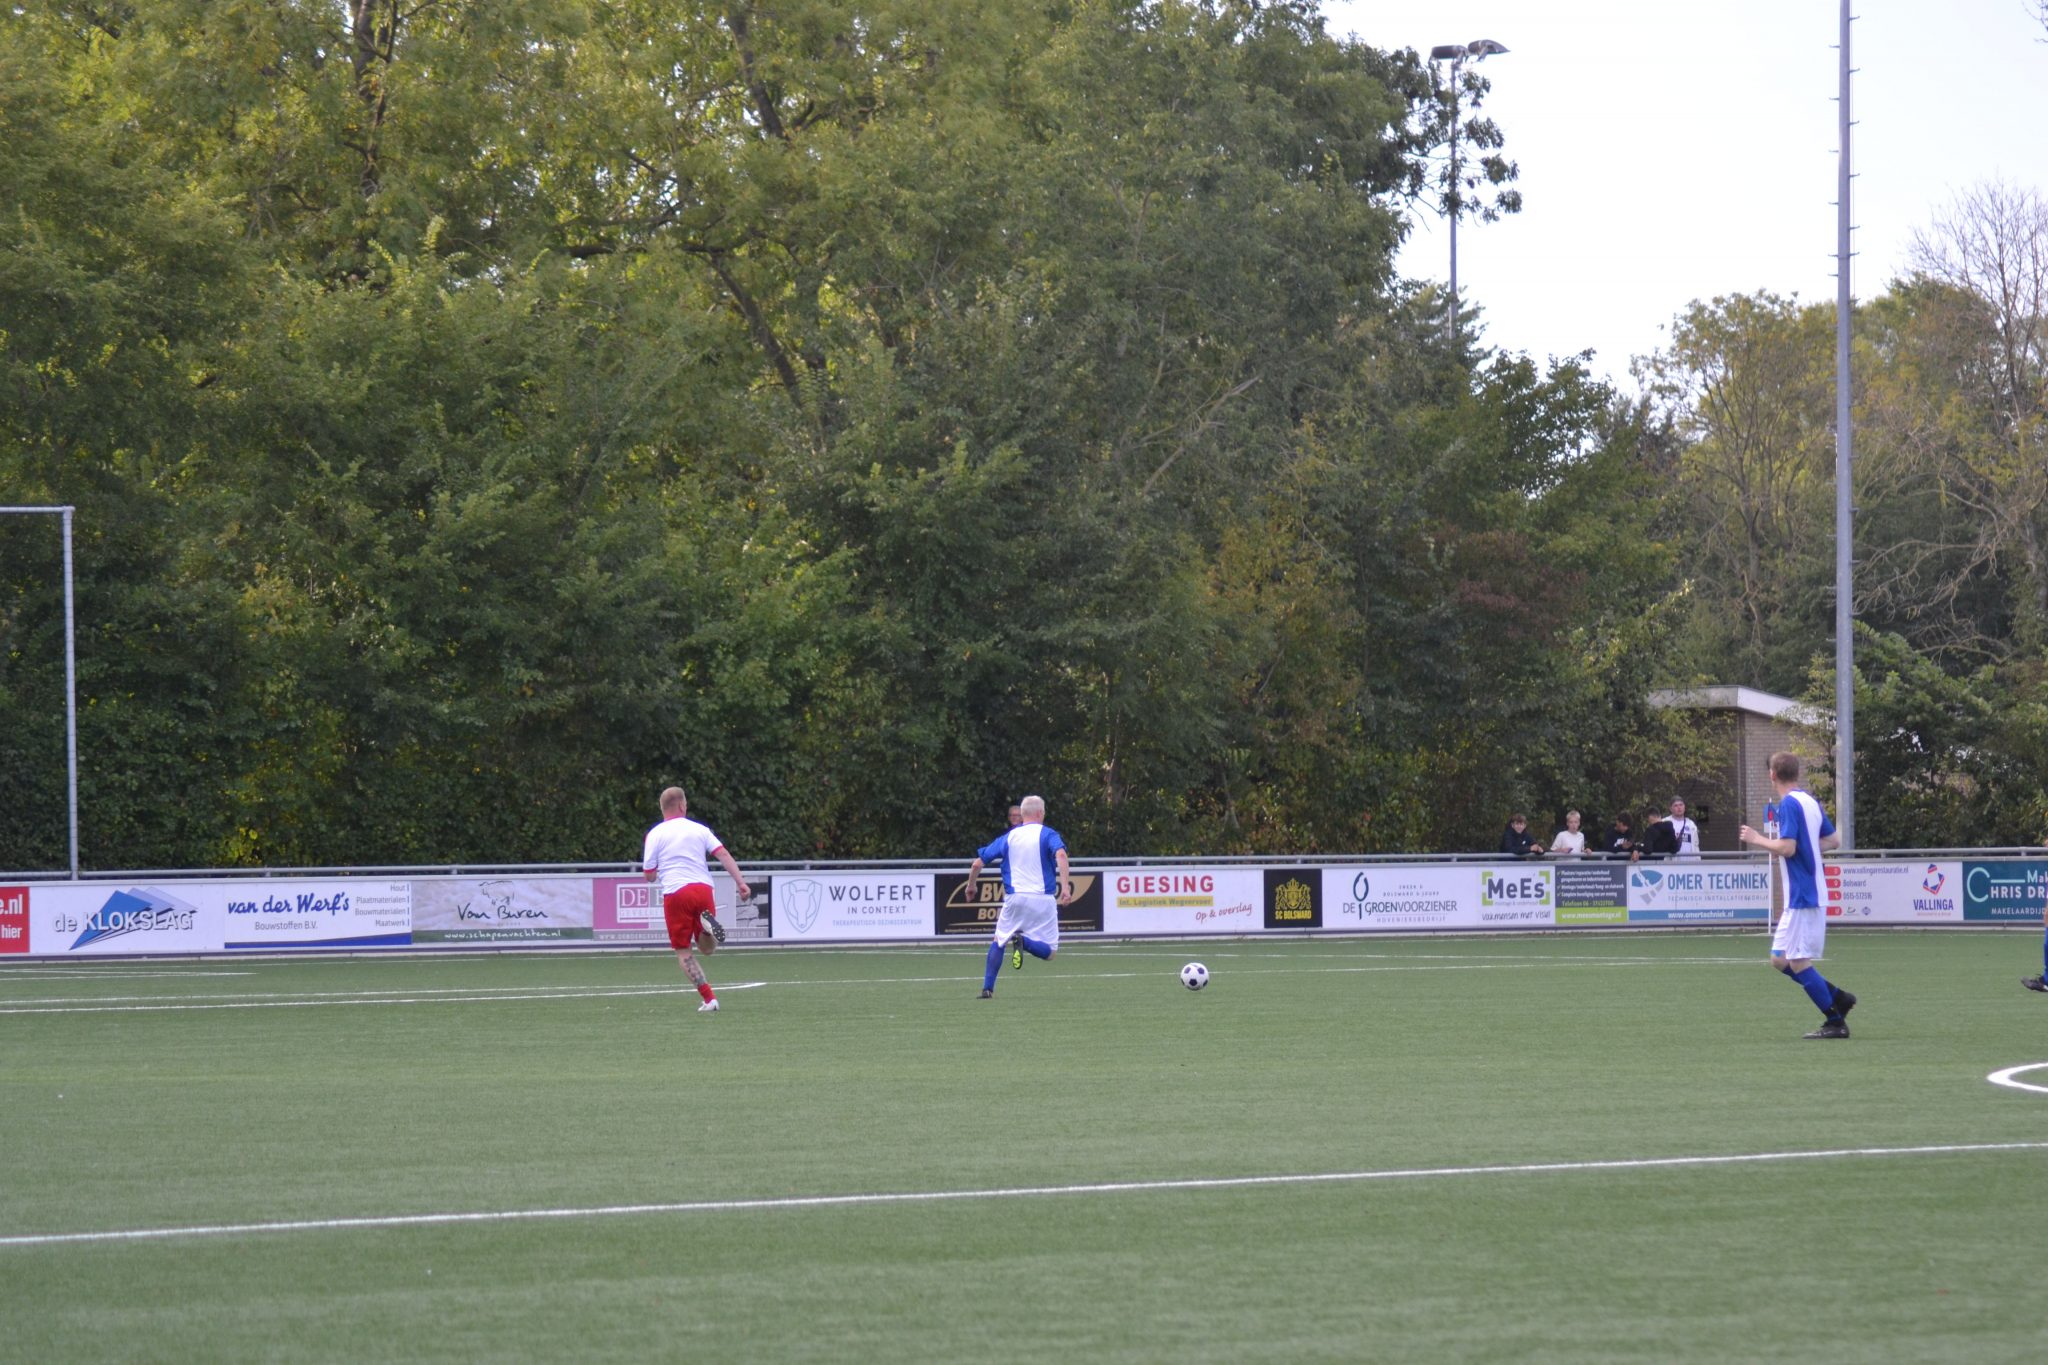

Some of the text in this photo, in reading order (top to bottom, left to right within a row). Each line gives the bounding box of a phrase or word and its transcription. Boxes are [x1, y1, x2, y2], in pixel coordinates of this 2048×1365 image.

[1117, 875, 1214, 894] GIESING
[1487, 877, 1545, 899] MeEs
[1668, 872, 1768, 890] OMER TECHNIEK
[621, 888, 648, 907] DE
[828, 884, 926, 901] WOLFERT
[228, 892, 350, 916] van der Werf's
[457, 903, 549, 921] Van Buren
[847, 905, 907, 914] IN CONTEXT
[1343, 900, 1458, 916] DE GROENVOORZIENER
[1913, 898, 1954, 911] VALLINGA
[54, 911, 194, 932] de KLOKSLAG
[254, 921, 318, 930] Bouwstoffen B.V.
[1, 924, 22, 938] hier
